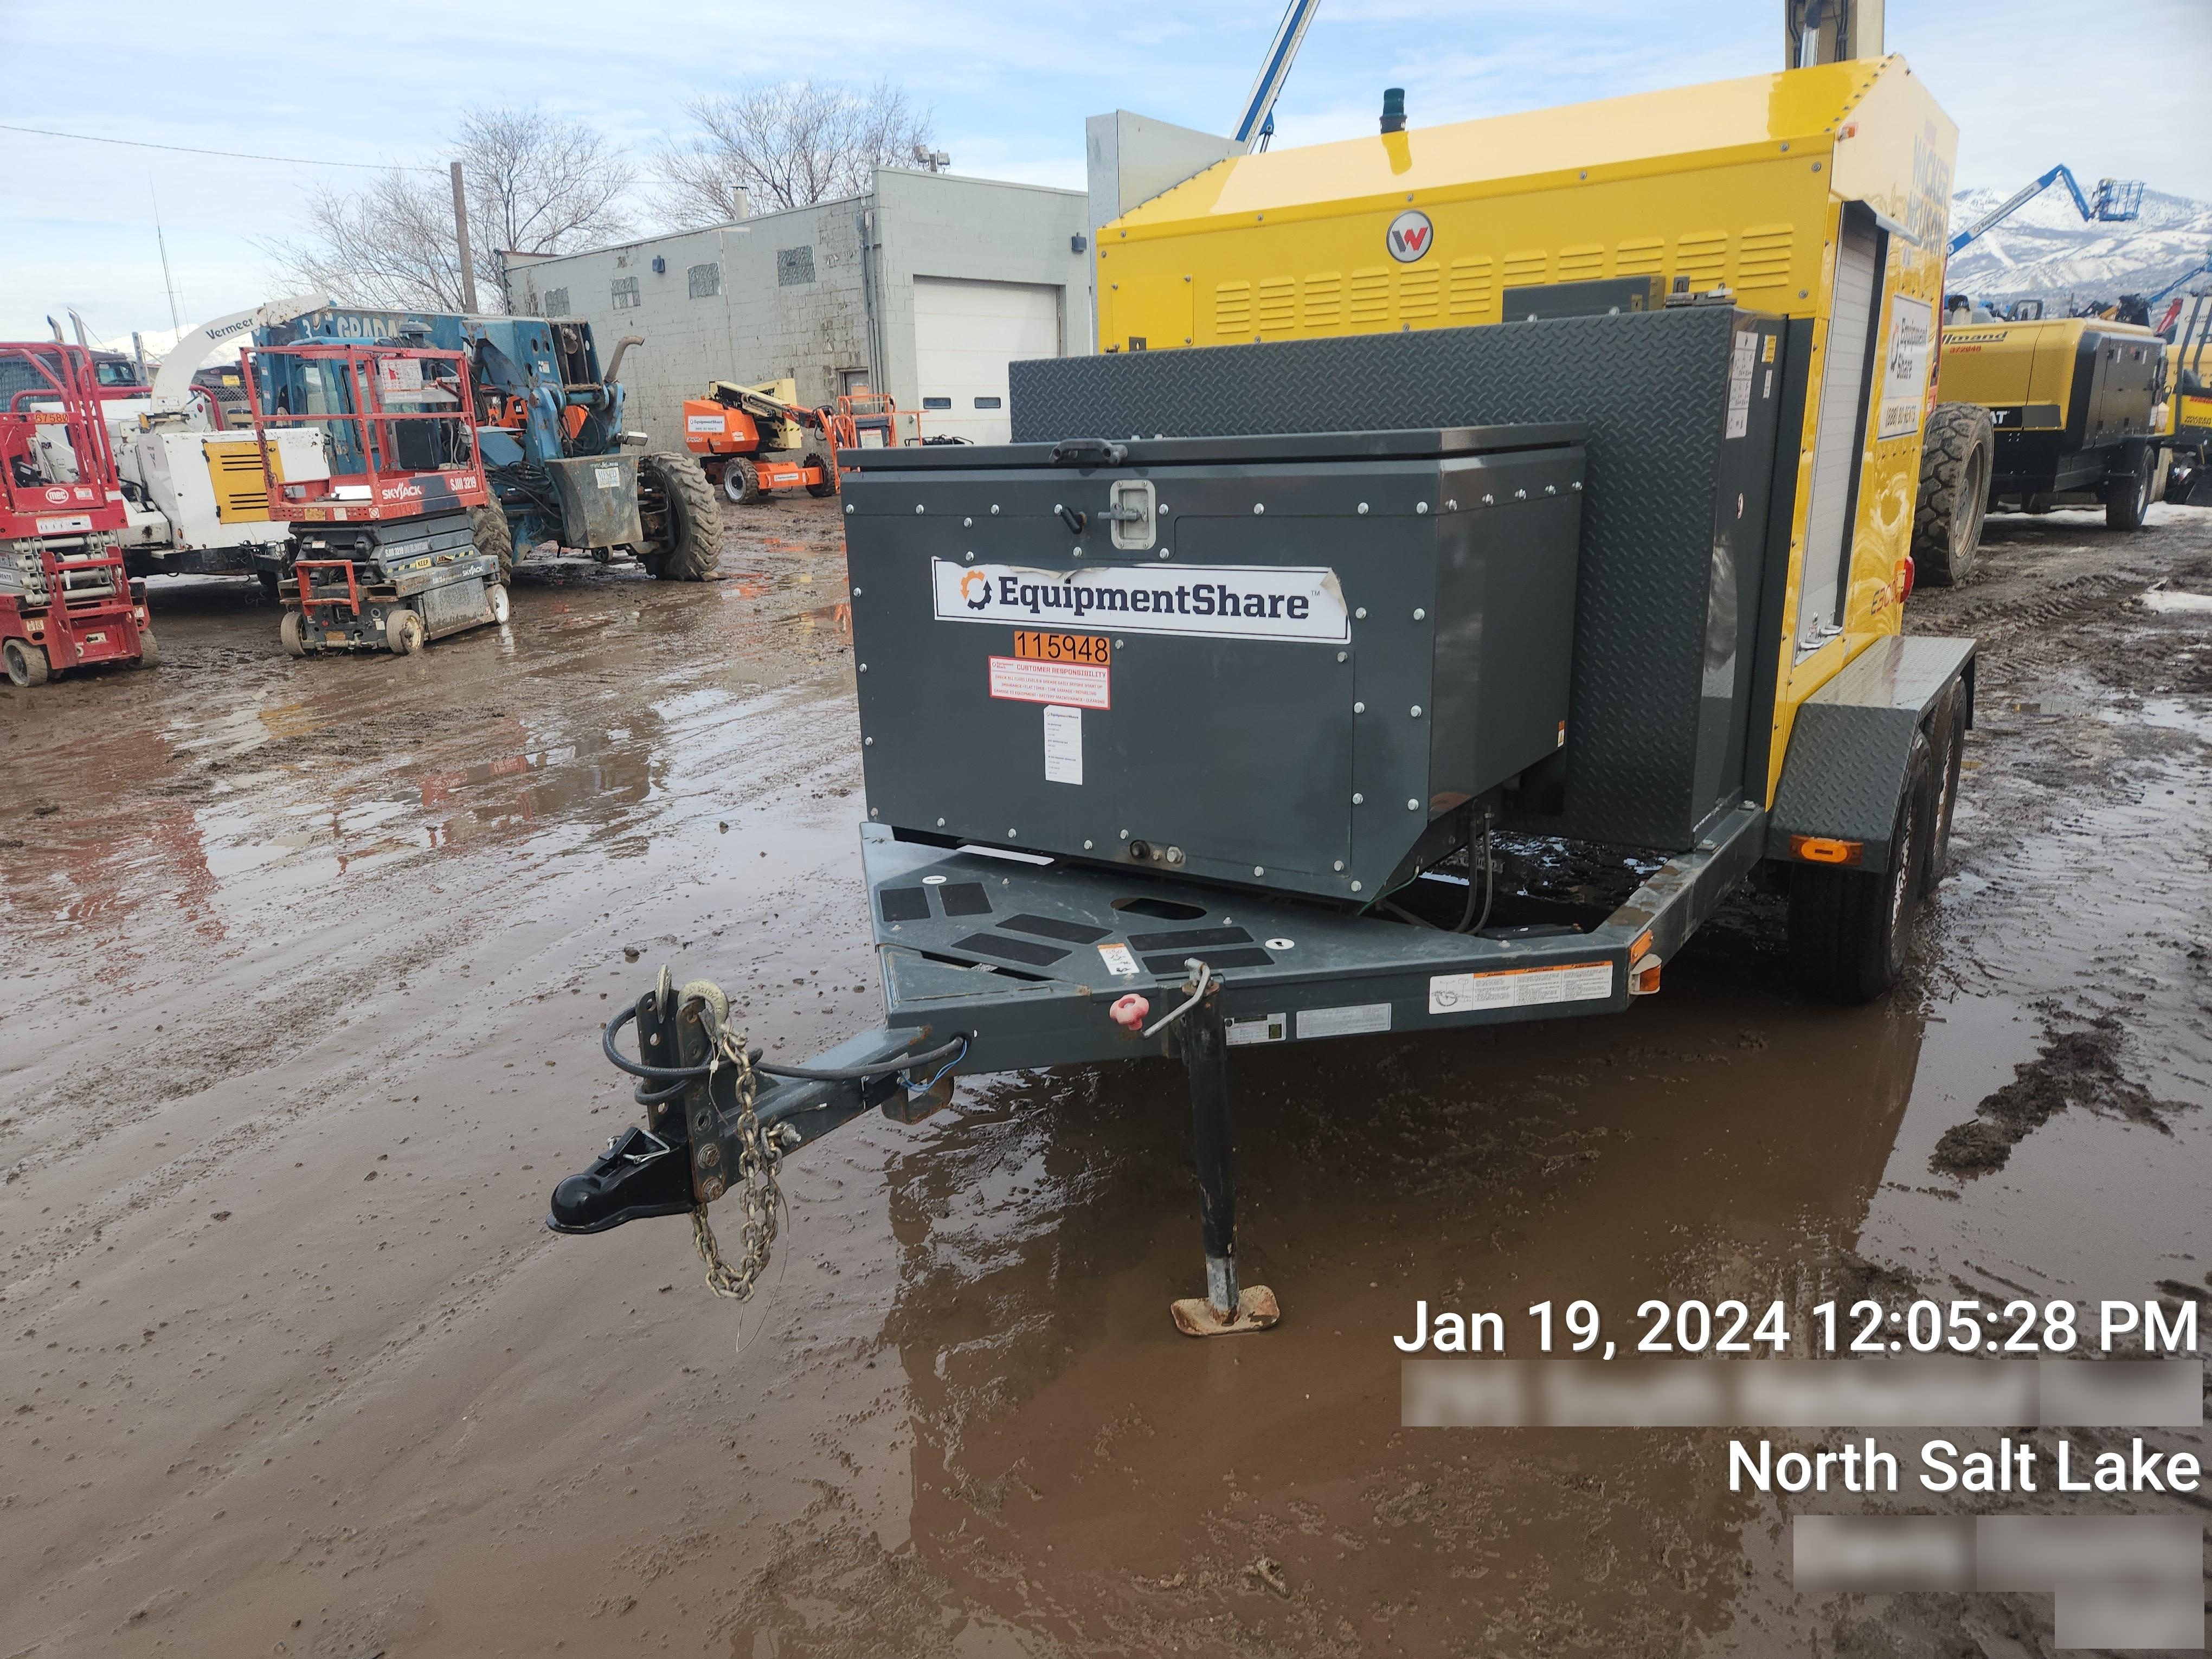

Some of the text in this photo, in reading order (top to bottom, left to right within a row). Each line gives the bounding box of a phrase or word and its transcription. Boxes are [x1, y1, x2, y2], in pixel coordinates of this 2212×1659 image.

[205, 318, 254, 340] Vermeer
[1900, 318, 1927, 351] Equipment
[1942, 331, 2008, 344] llmand
[1896, 355, 1913, 380] Share
[1990, 410, 2008, 425] AT
[382, 481, 422, 500] SKYJACK
[464, 476, 477, 488] 3219
[998, 576, 1309, 620] EquipmentShare
[1017, 632, 1108, 663] 115948
[1017, 664, 1106, 678] CUSTOMER RESPONSIBILITY
